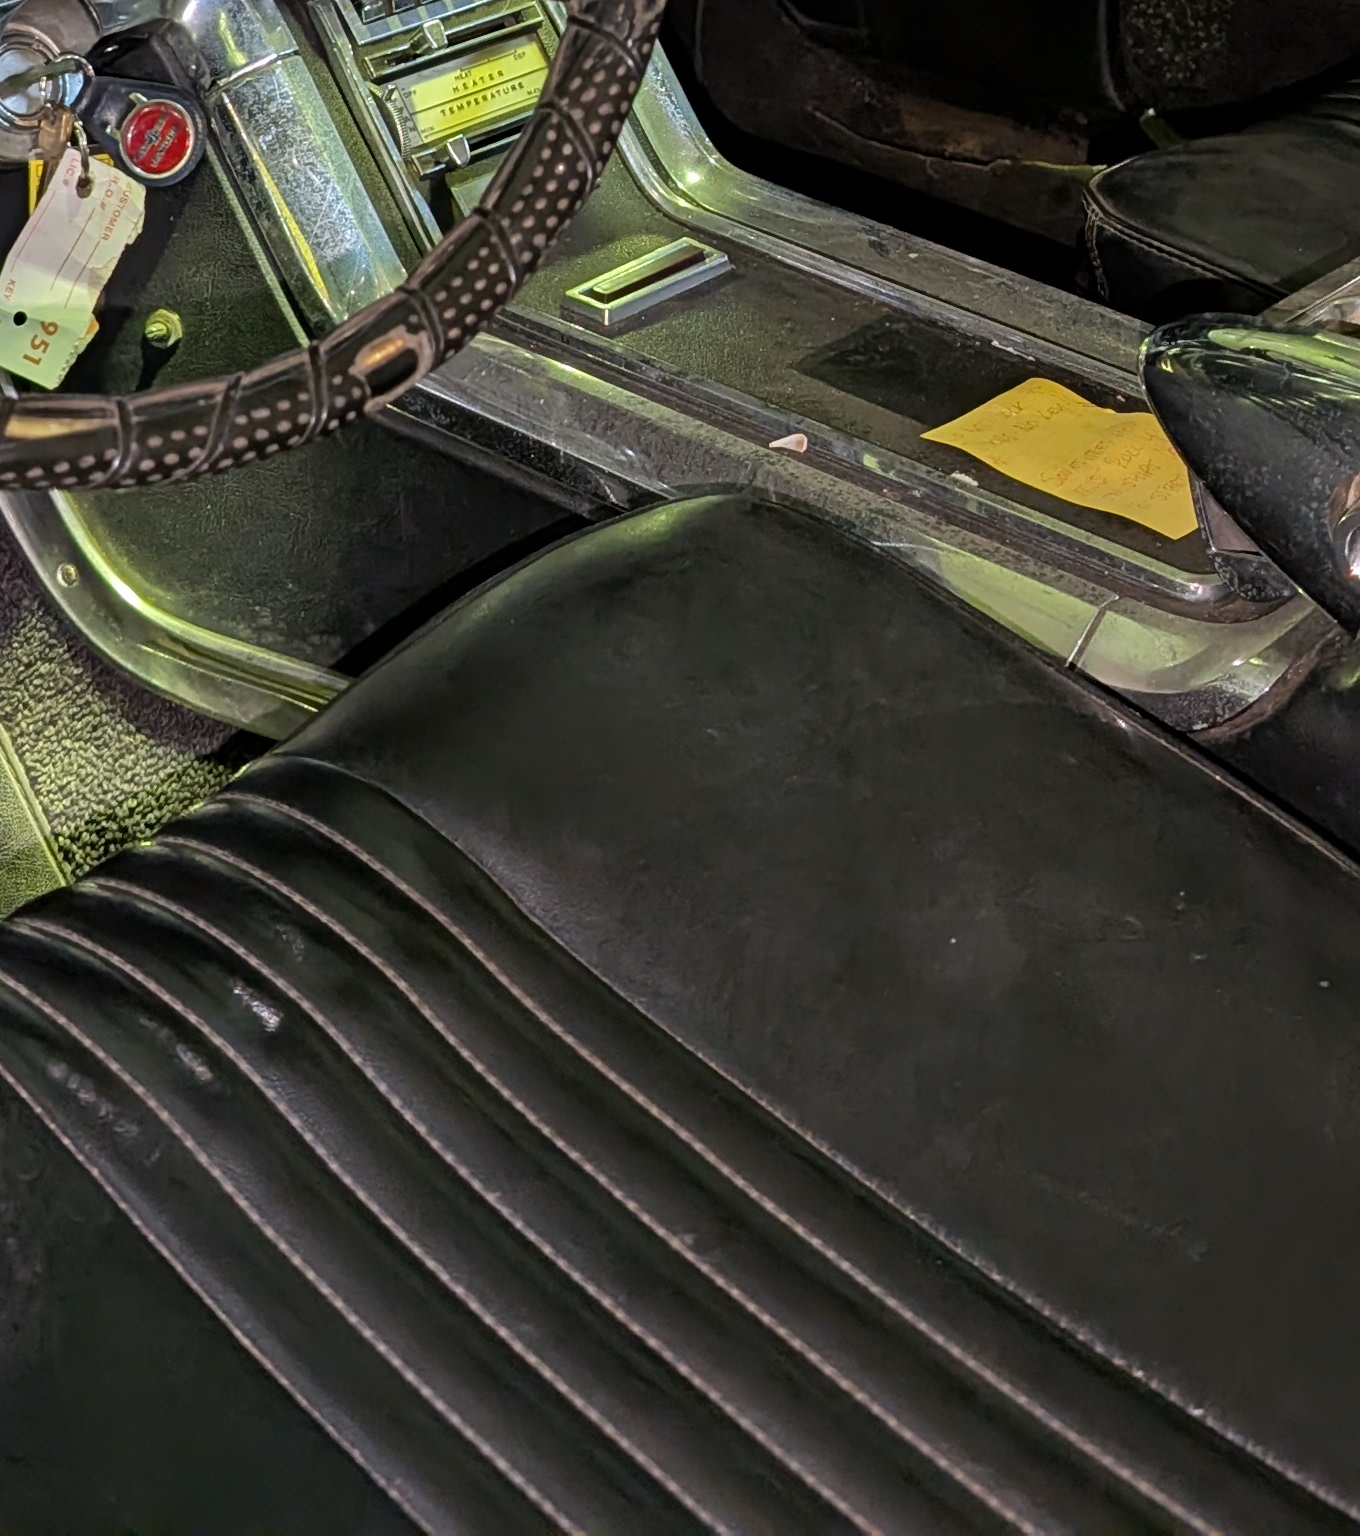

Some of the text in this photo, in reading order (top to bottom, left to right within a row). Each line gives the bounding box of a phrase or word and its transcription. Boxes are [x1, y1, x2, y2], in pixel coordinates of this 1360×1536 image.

[452, 69, 505, 93] HEATER
[454, 70, 473, 81] HEAT
[440, 81, 526, 117] TEMPERATURE
[2, 278, 16, 302] KEY
[22, 319, 59, 367] 951
